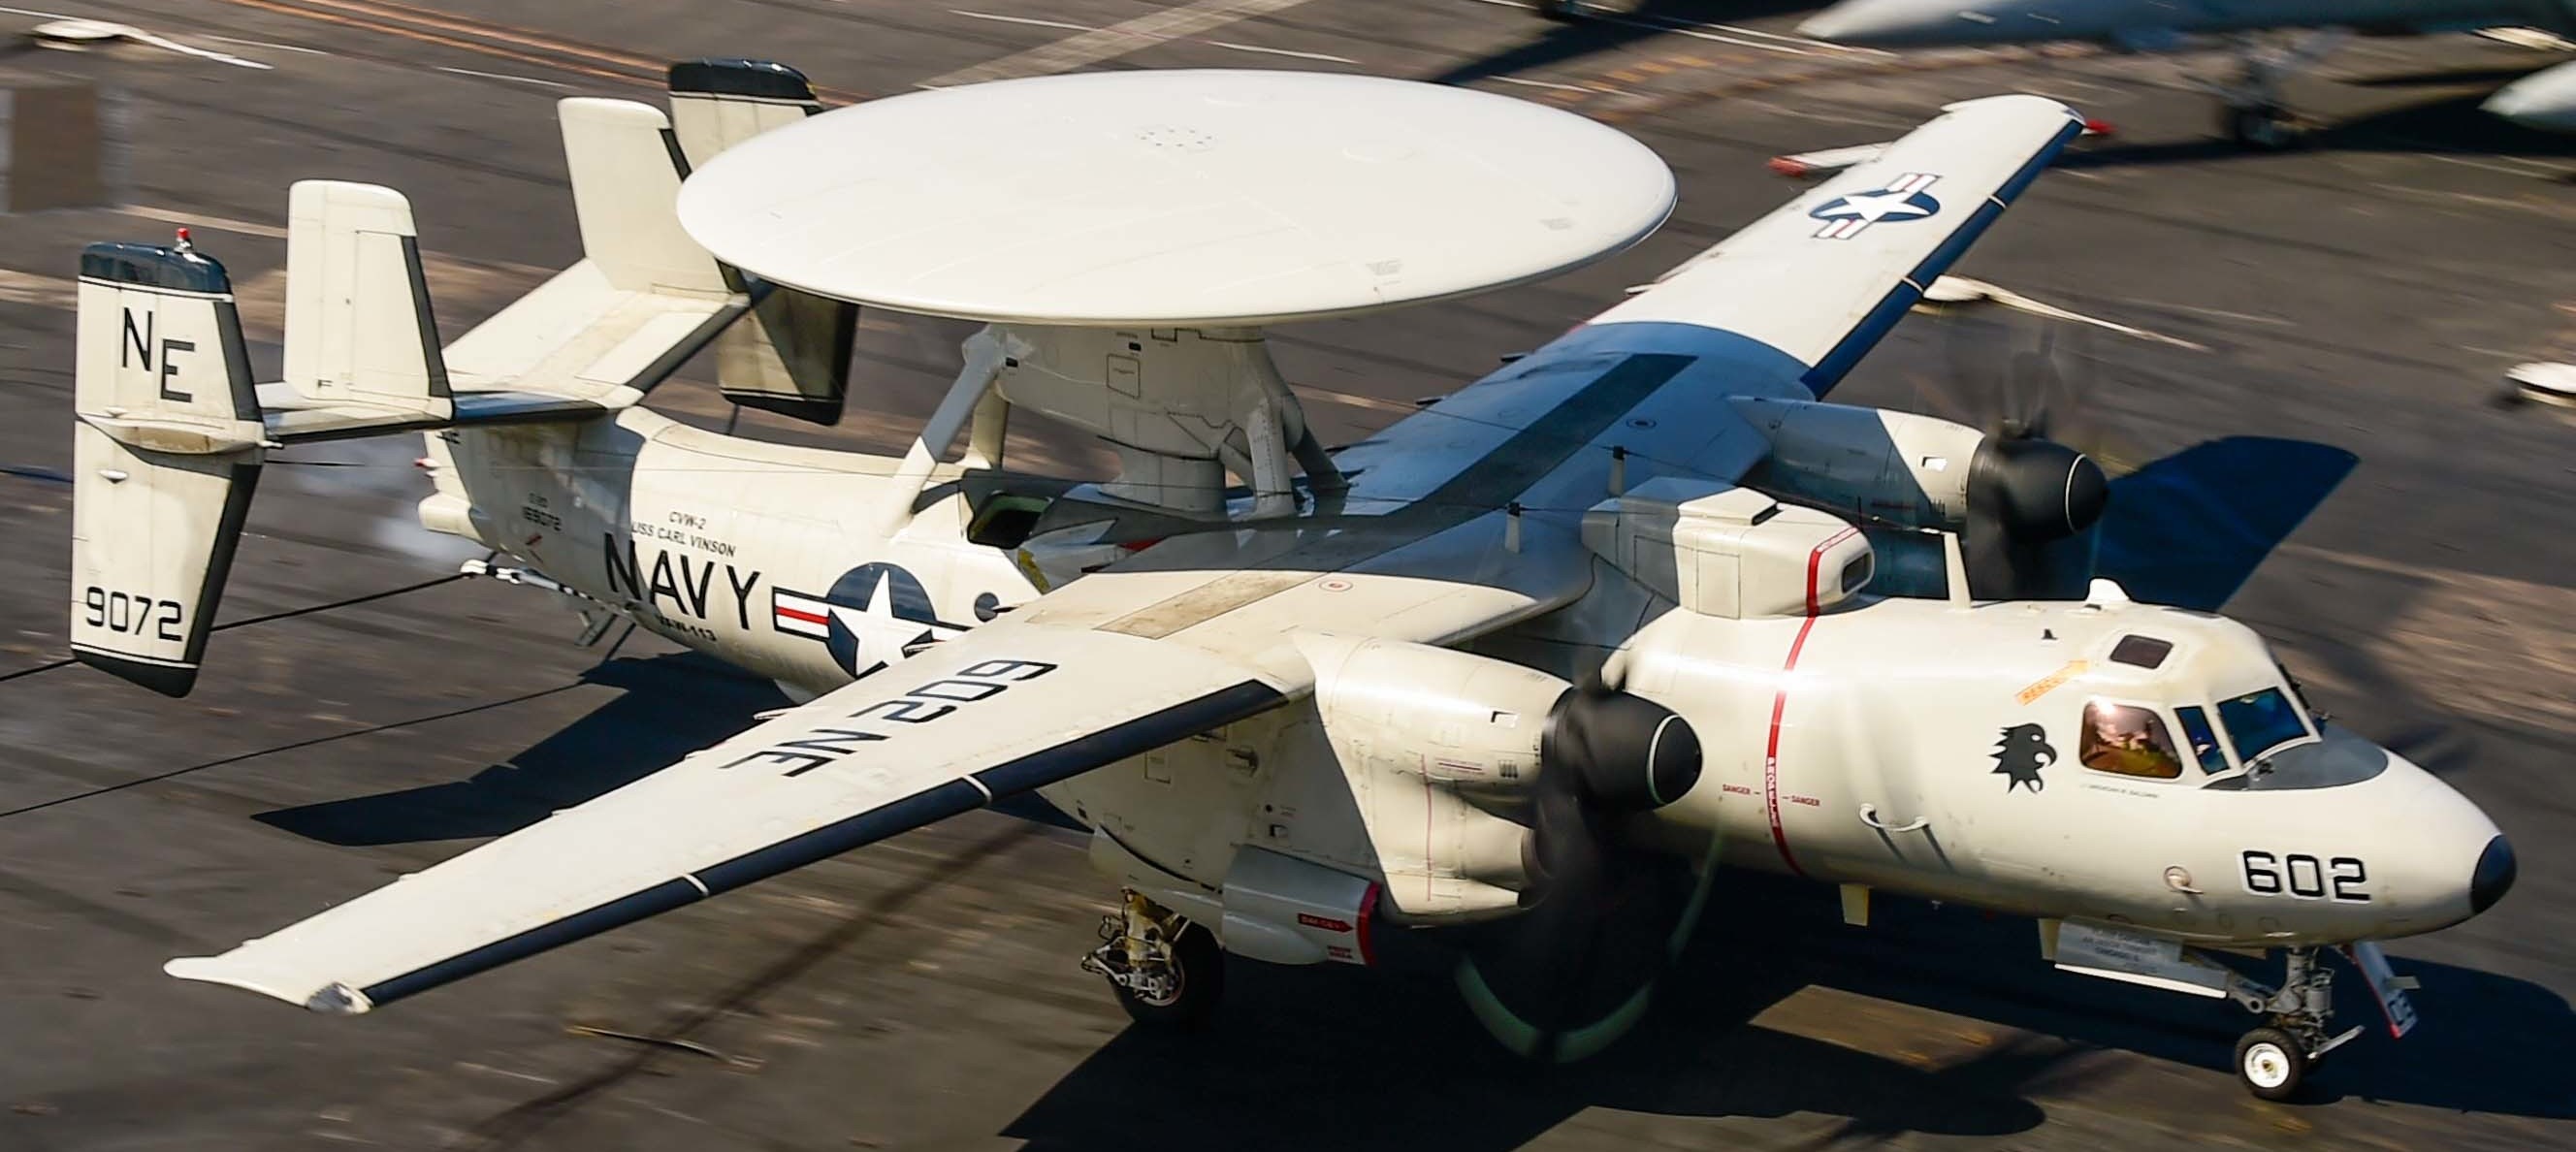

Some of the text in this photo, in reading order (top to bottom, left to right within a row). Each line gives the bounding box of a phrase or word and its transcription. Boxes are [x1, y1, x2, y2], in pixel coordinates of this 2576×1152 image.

[630, 521, 736, 559] USS CARL VINSON
[668, 511, 707, 530] CVW-2
[604, 531, 761, 631] NAVY
[85, 586, 183, 643] 9072
[718, 659, 1058, 778] 602 NE
[2241, 849, 2371, 902] 602
